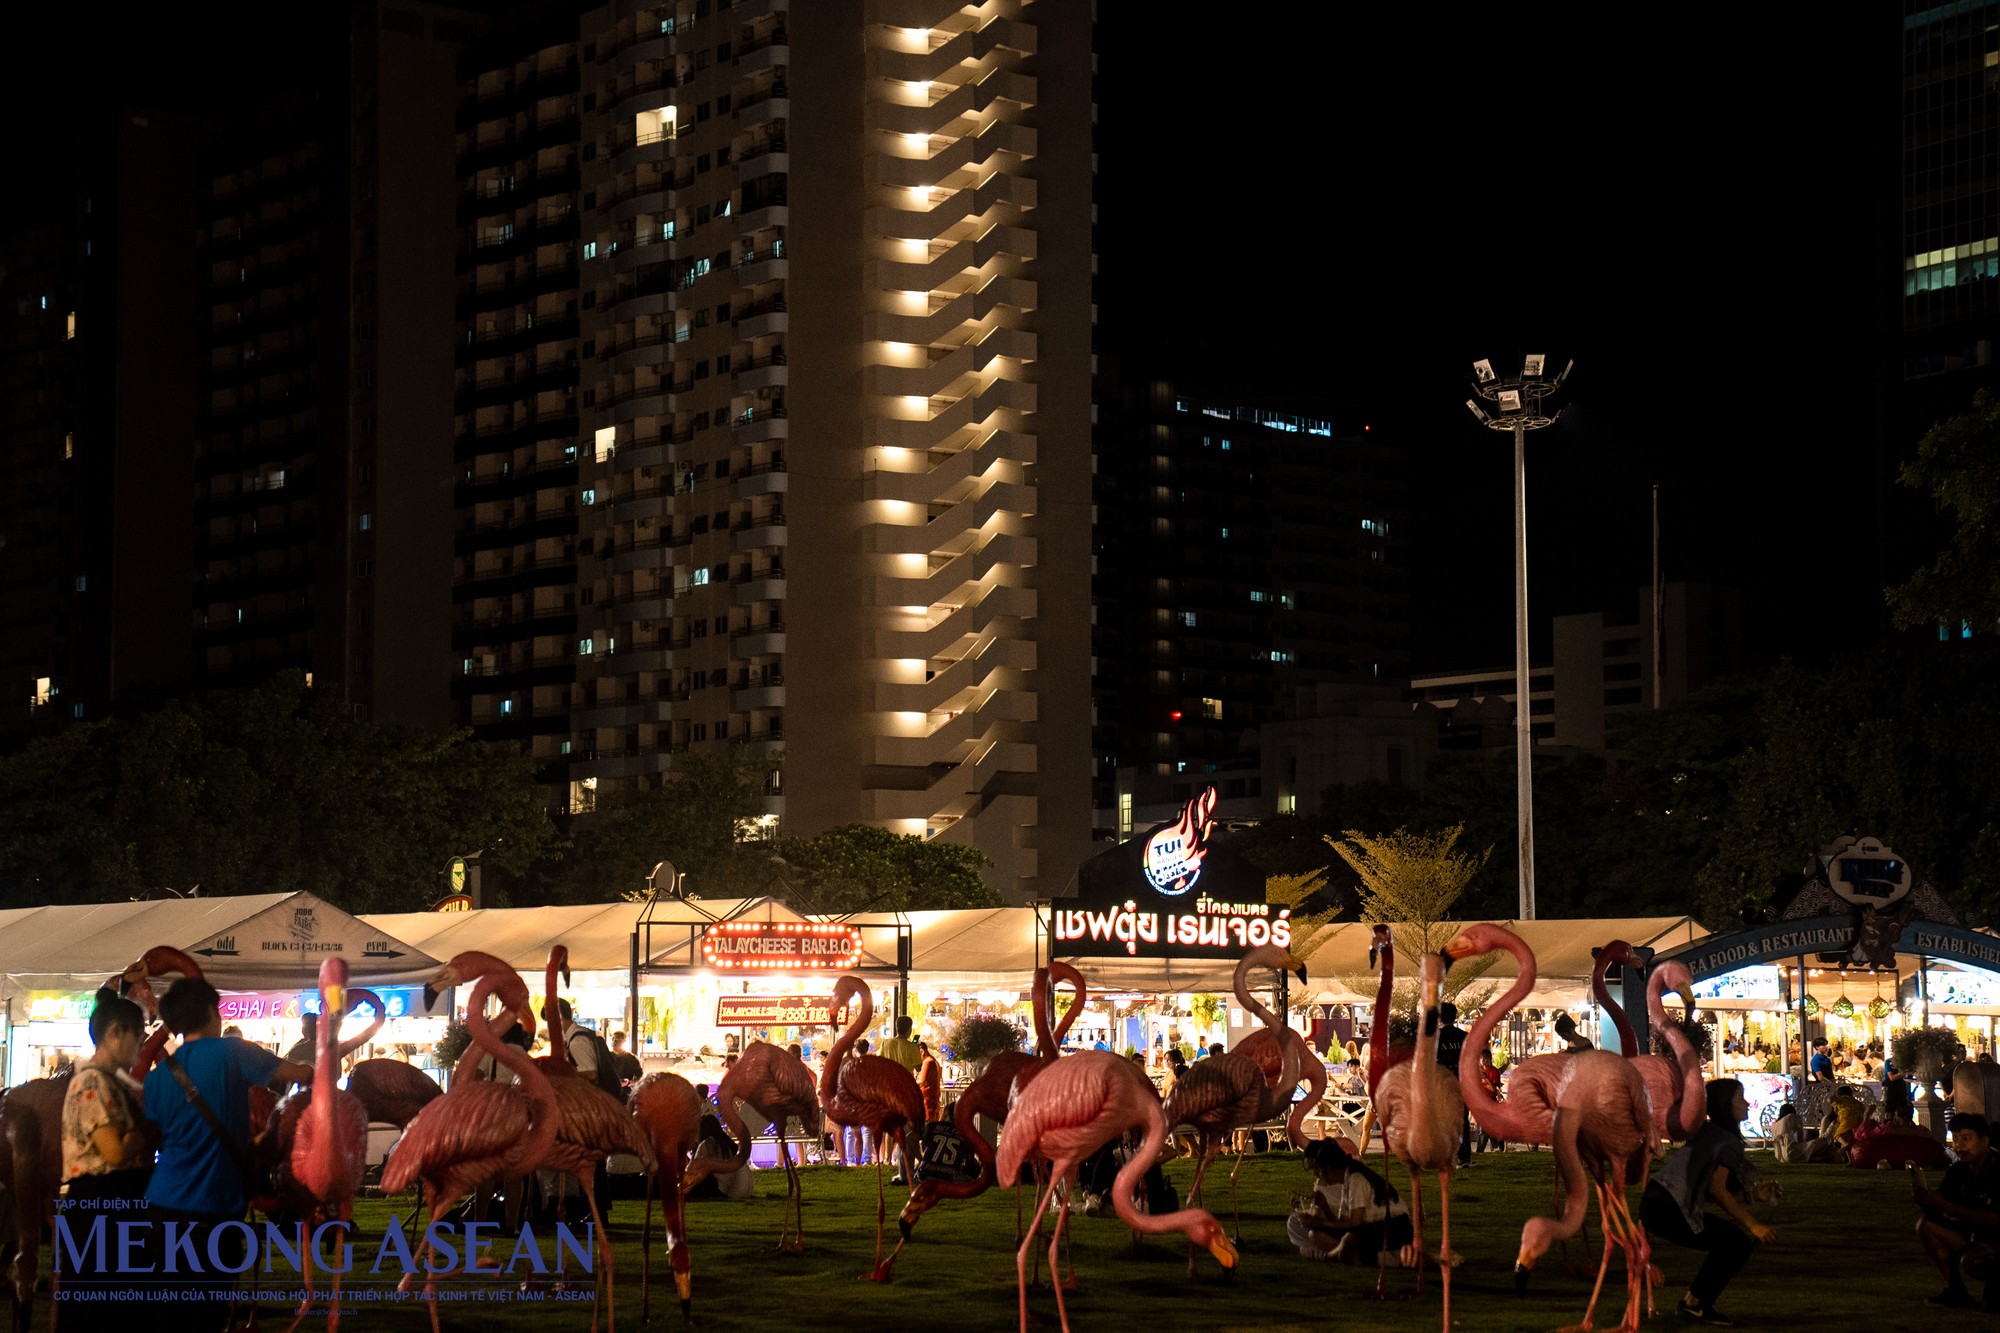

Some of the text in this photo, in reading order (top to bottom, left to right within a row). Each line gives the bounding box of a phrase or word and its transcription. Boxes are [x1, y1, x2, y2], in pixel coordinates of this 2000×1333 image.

[1154, 839, 1181, 856] TUI
[1167, 909, 1291, 948] เรนเจอร์
[216, 936, 235, 950] odd
[262, 942, 288, 951] BLOCK
[366, 941, 388, 952] even
[713, 937, 796, 955] TALAYCHEESE
[1688, 927, 1855, 976] EA FOOD & RESTAURANT
[930, 1134, 961, 1165] 75
